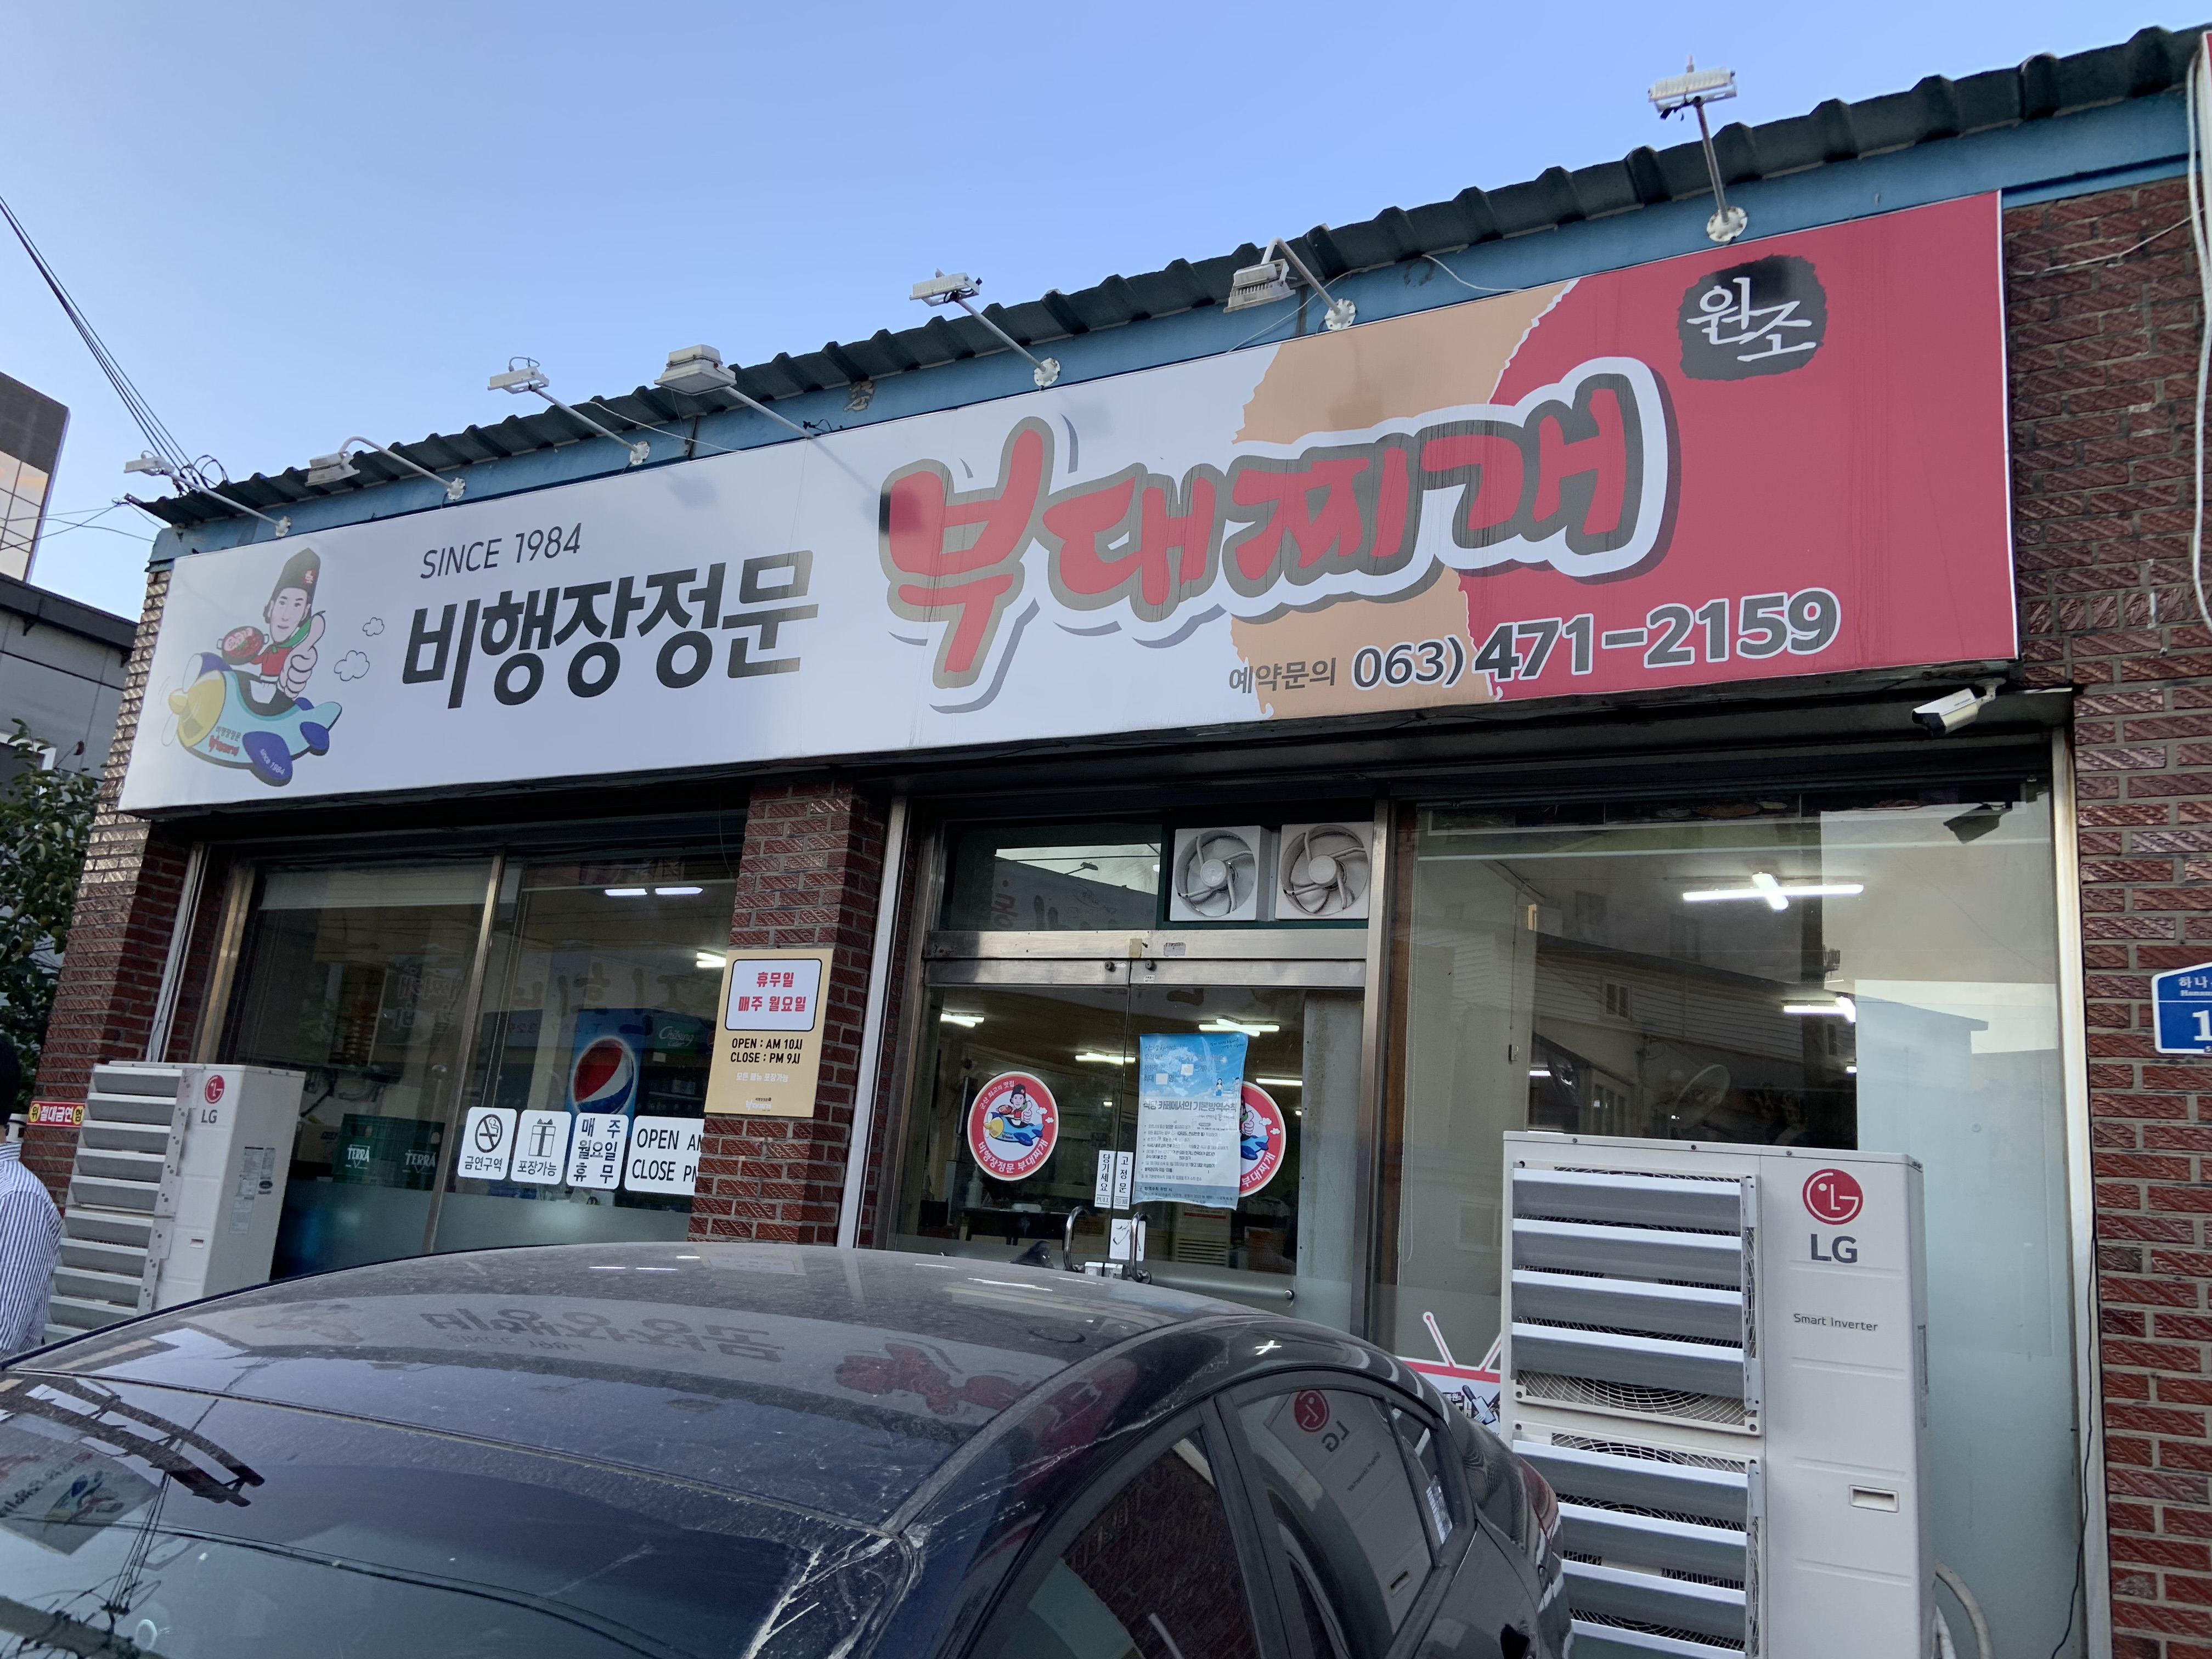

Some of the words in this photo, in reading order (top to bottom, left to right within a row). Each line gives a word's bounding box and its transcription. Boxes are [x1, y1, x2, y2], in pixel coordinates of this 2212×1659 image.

[1687, 276, 1817, 364] 원조
[881, 362, 1665, 689] 부대찌개
[419, 538, 500, 579] SINCE
[514, 522, 582, 565] 1984
[402, 550, 819, 710] 비행장정문
[1228, 657, 1337, 695] 예약문의
[756, 972, 794, 988] 휴무일
[2179, 976, 2212, 988] 하나
[738, 996, 763, 1012] 매주
[769, 996, 806, 1012] 월요일
[732, 1039, 758, 1049] OPEN
[765, 1039, 781, 1049] AM
[784, 1039, 803, 1050] 10시
[730, 1052, 760, 1063] CLOSE
[769, 1053, 785, 1064] PM
[787, 1053, 801, 1064] 9시
[764, 1073, 789, 1082] 포장가능
[40, 1105, 74, 1123] 절대금연
[1158, 1100, 1192, 1111] 카페에서의
[1193, 1101, 1237, 1113] 기본방역수칙
[201, 1109, 218, 1124] LG
[637, 1127, 680, 1150] OPEN
[347, 1147, 370, 1163] TERRA
[405, 1151, 437, 1168] TERRA
[578, 1139, 618, 1162] 월요일
[978, 1141, 1015, 1174] 비행장정문
[1018, 1138, 1049, 1171] 부대찌개
[465, 1155, 503, 1172] 금연구역
[517, 1160, 557, 1177] 포장가능
[632, 1159, 676, 1181] CLOSE
[1099, 1153, 1110, 1192] 당기세요
[1242, 1152, 1276, 1187] 부대찌개
[1810, 1233, 1858, 1263] LG
[1793, 1313, 1826, 1327] Smart
[1831, 1317, 1878, 1331] Inverter
